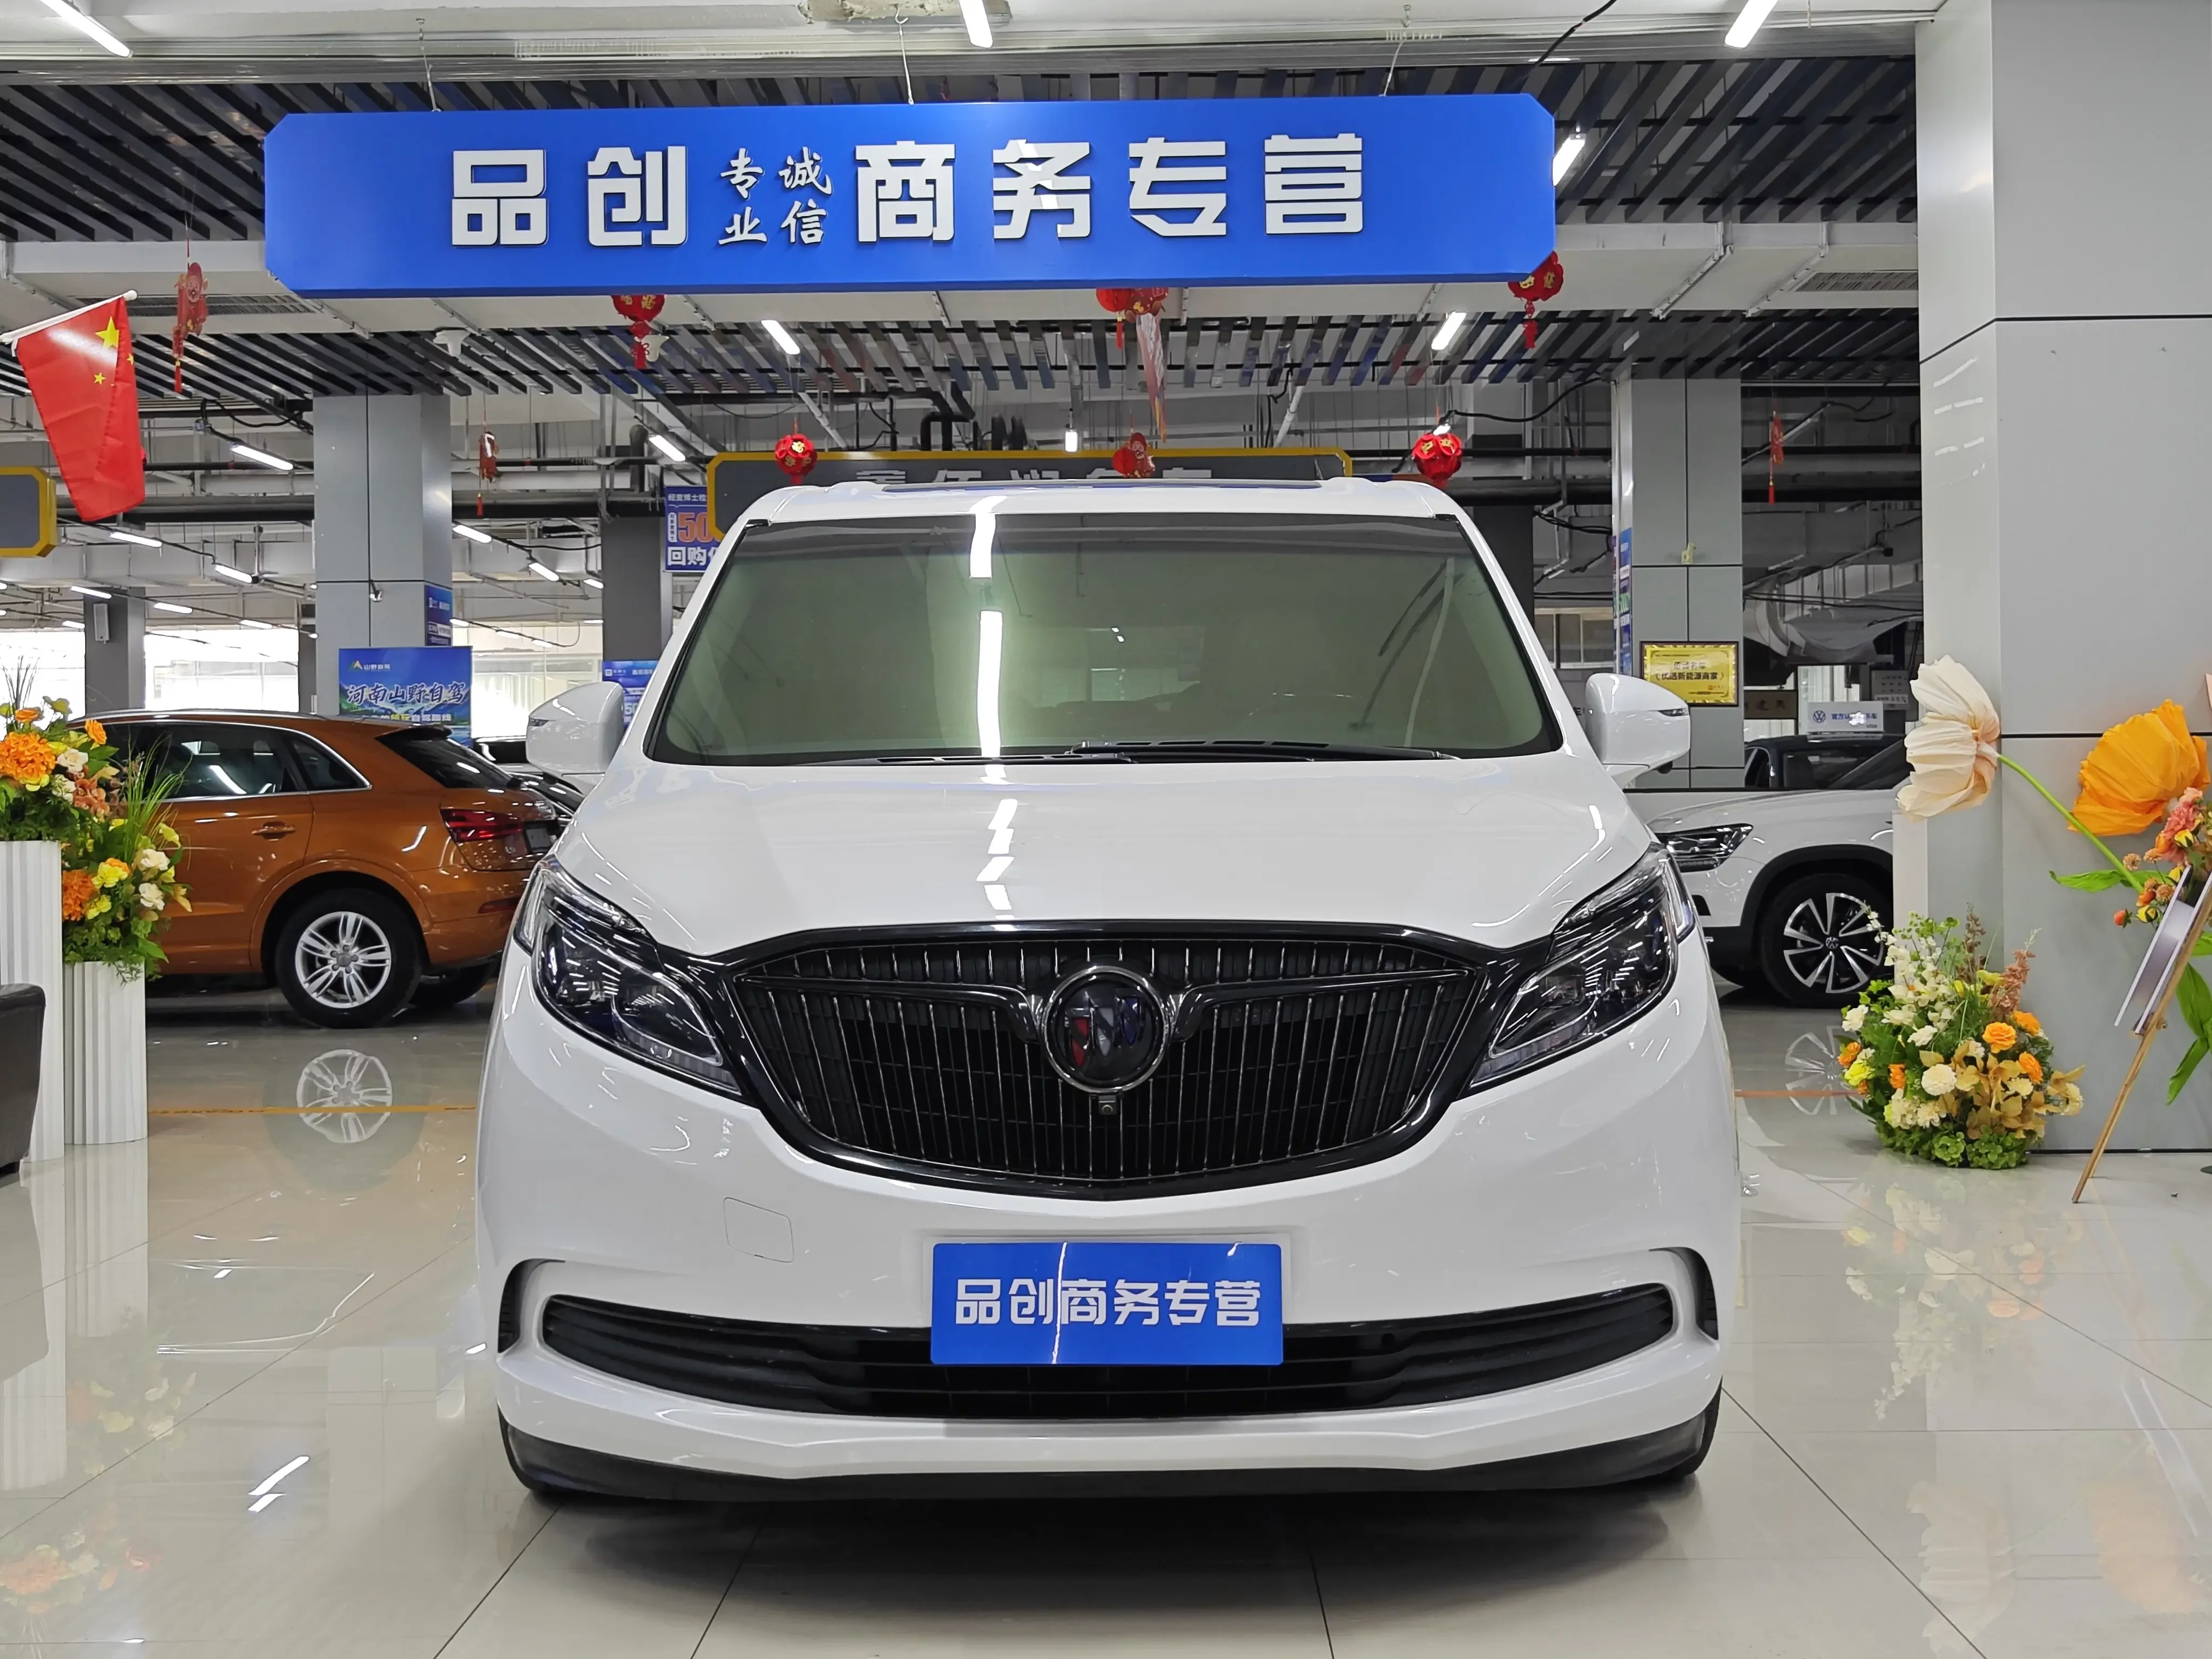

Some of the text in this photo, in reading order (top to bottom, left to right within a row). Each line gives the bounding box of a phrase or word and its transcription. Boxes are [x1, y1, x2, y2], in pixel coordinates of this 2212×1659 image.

[451, 145, 687, 247] 品创
[718, 147, 767, 245] 专业
[778, 146, 833, 244] 诚信
[855, 133, 1364, 242] 商务专营
[678, 512, 721, 543] 50
[347, 680, 466, 706] 河南山野自驾
[955, 1278, 1262, 1326] 品创商务专营
